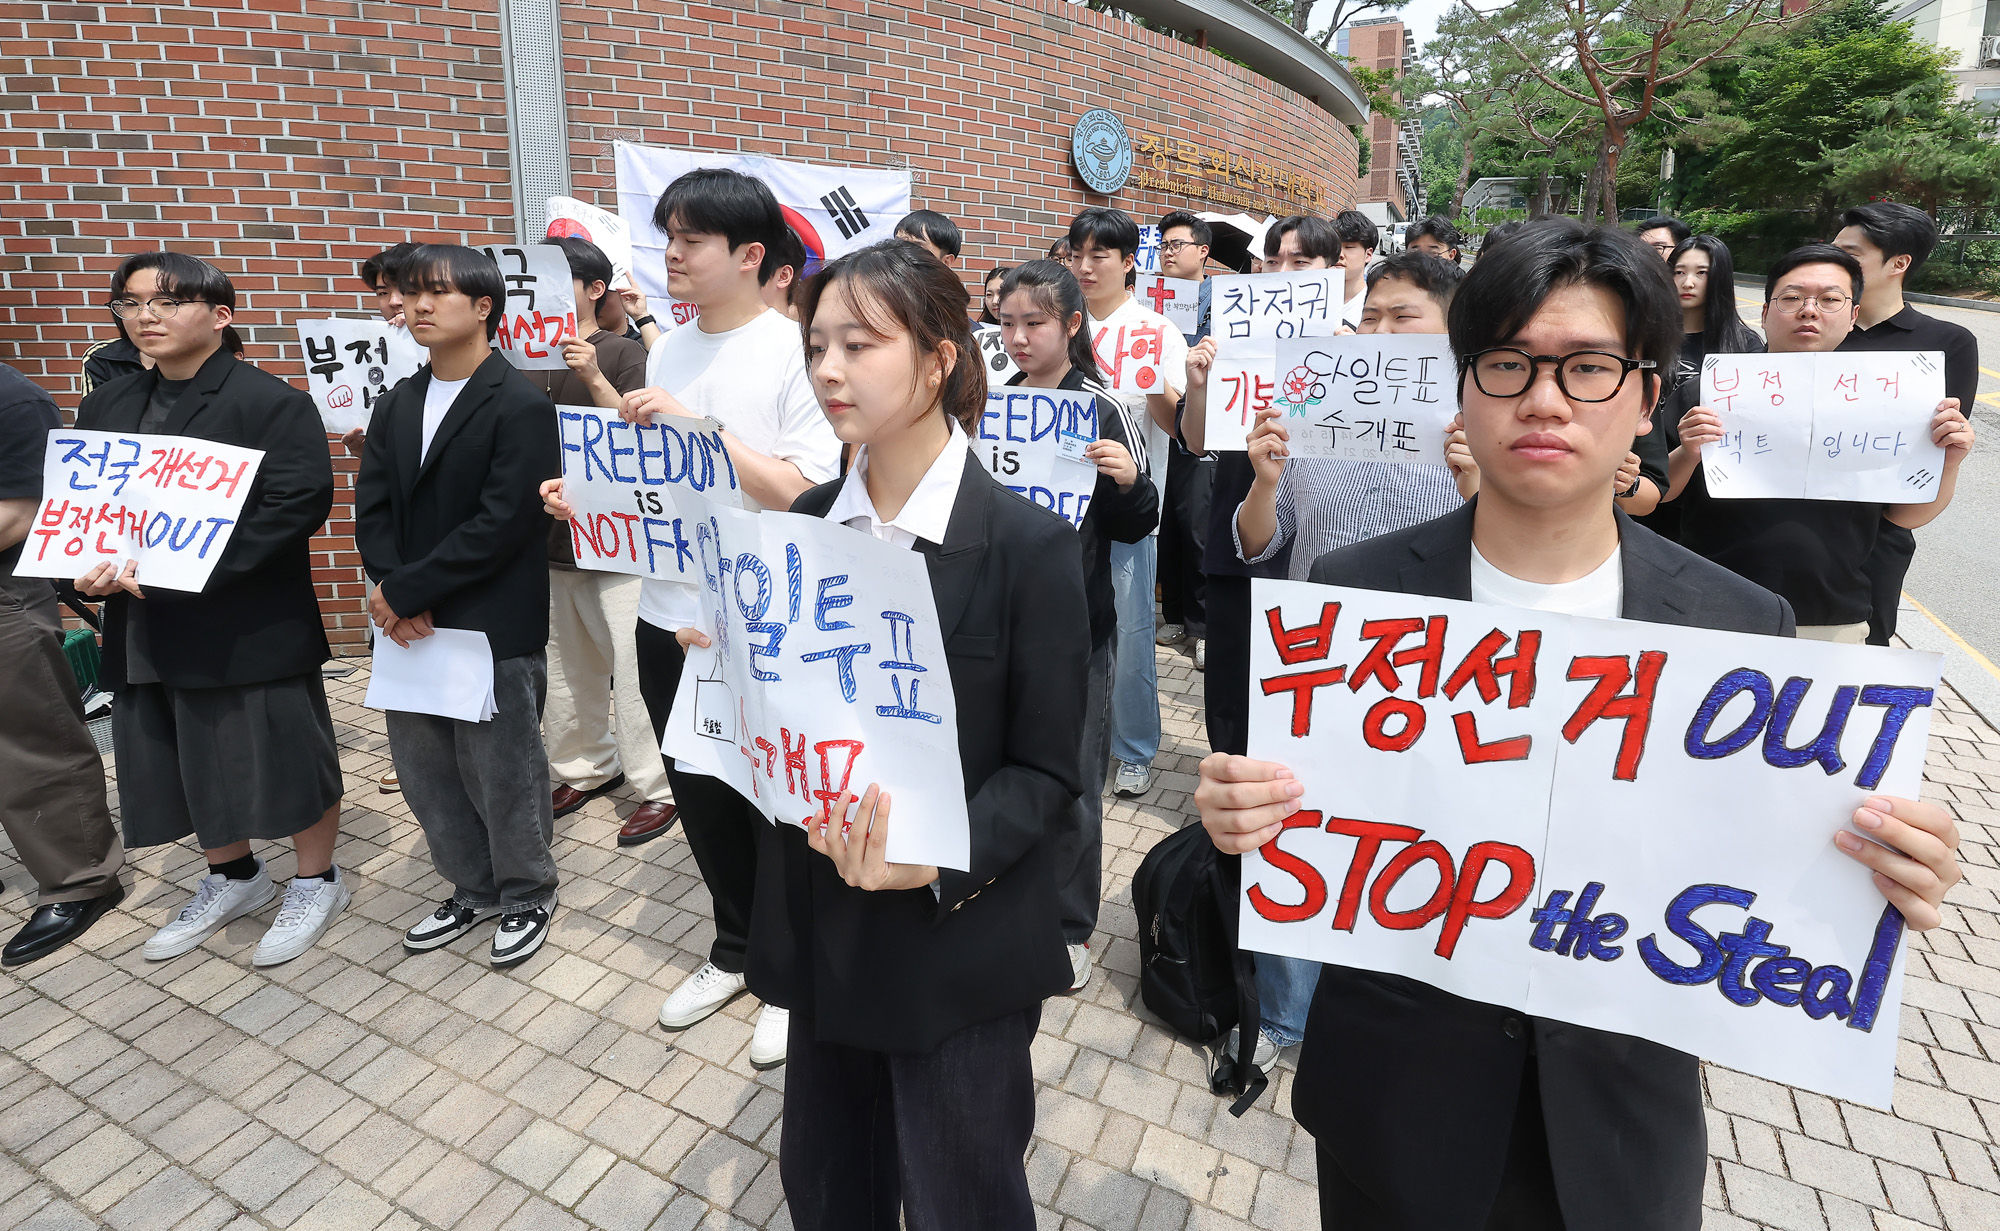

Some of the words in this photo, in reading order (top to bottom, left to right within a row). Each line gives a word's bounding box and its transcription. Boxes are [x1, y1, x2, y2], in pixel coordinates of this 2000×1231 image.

[1076, 156, 1094, 185] PIETAS
[1095, 181, 1104, 190] ET
[1105, 165, 1129, 191] SCIENTIA
[1139, 169, 1203, 197] Presbyterian
[1207, 184, 1250, 211] University
[1140, 134, 1327, 210] 장로회신학대학교
[1222, 277, 1329, 339] 참정권
[305, 335, 389, 386] 부정
[1091, 319, 1167, 390] 사형
[1303, 350, 1440, 405] 당일투표
[1713, 367, 1785, 412] 부정
[1833, 371, 1900, 402] 선거
[980, 392, 1098, 444] EEDOM
[1314, 409, 1421, 452] 수개표
[55, 438, 142, 496] 전국
[138, 447, 249, 499] 재선거
[559, 411, 737, 493] FREEDOM
[992, 446, 1020, 475] is
[1822, 431, 1907, 459] 입니다
[633, 489, 663, 515] is
[570, 511, 640, 562] NOT
[695, 516, 942, 724] 당일투표
[1260, 601, 1668, 782] 부정선거
[1684, 667, 1933, 790] OUT
[1247, 808, 1537, 960] STOP
[1528, 881, 1629, 962] the
[1637, 883, 1898, 1033] Steal
